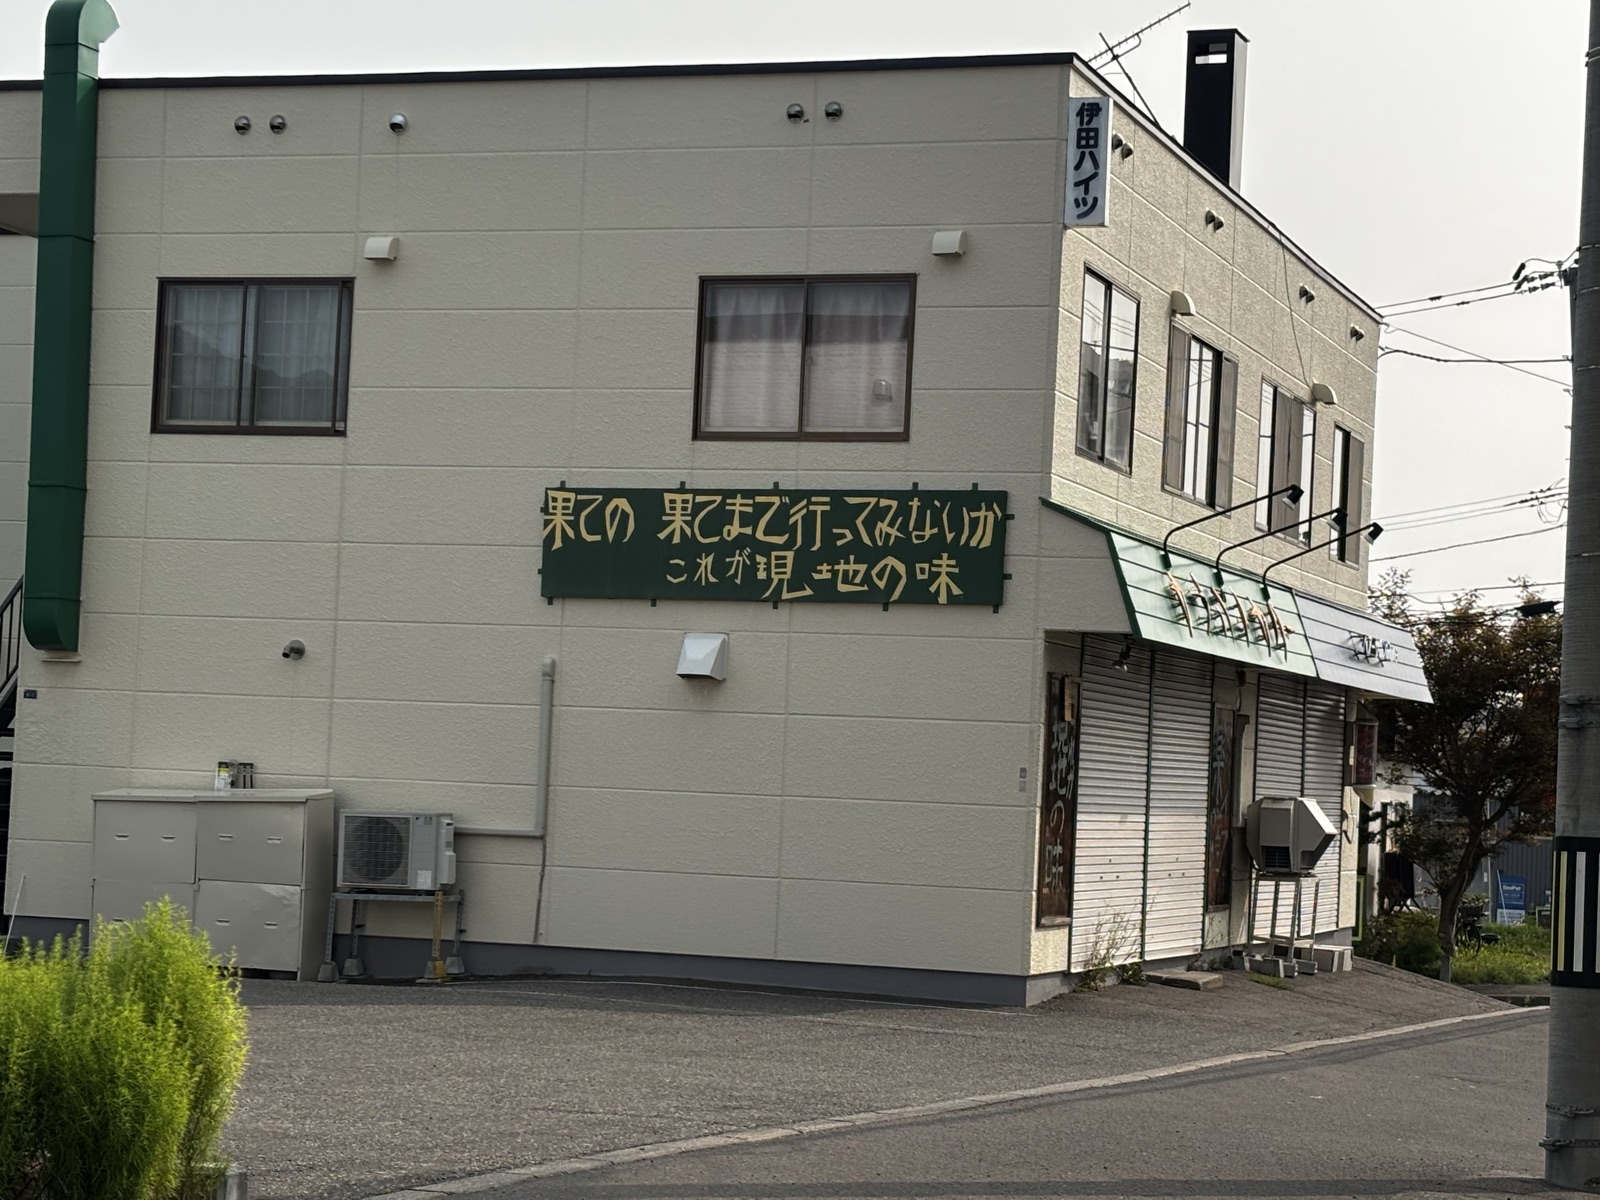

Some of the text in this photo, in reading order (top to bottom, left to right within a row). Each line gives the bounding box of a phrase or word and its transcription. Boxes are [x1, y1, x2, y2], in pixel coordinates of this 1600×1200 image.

[1073, 102, 1102, 220] 伊田ハイツ
[542, 489, 1002, 551] 果ての 果てまで行ってみないか
[665, 547, 964, 604] これが現地の味
